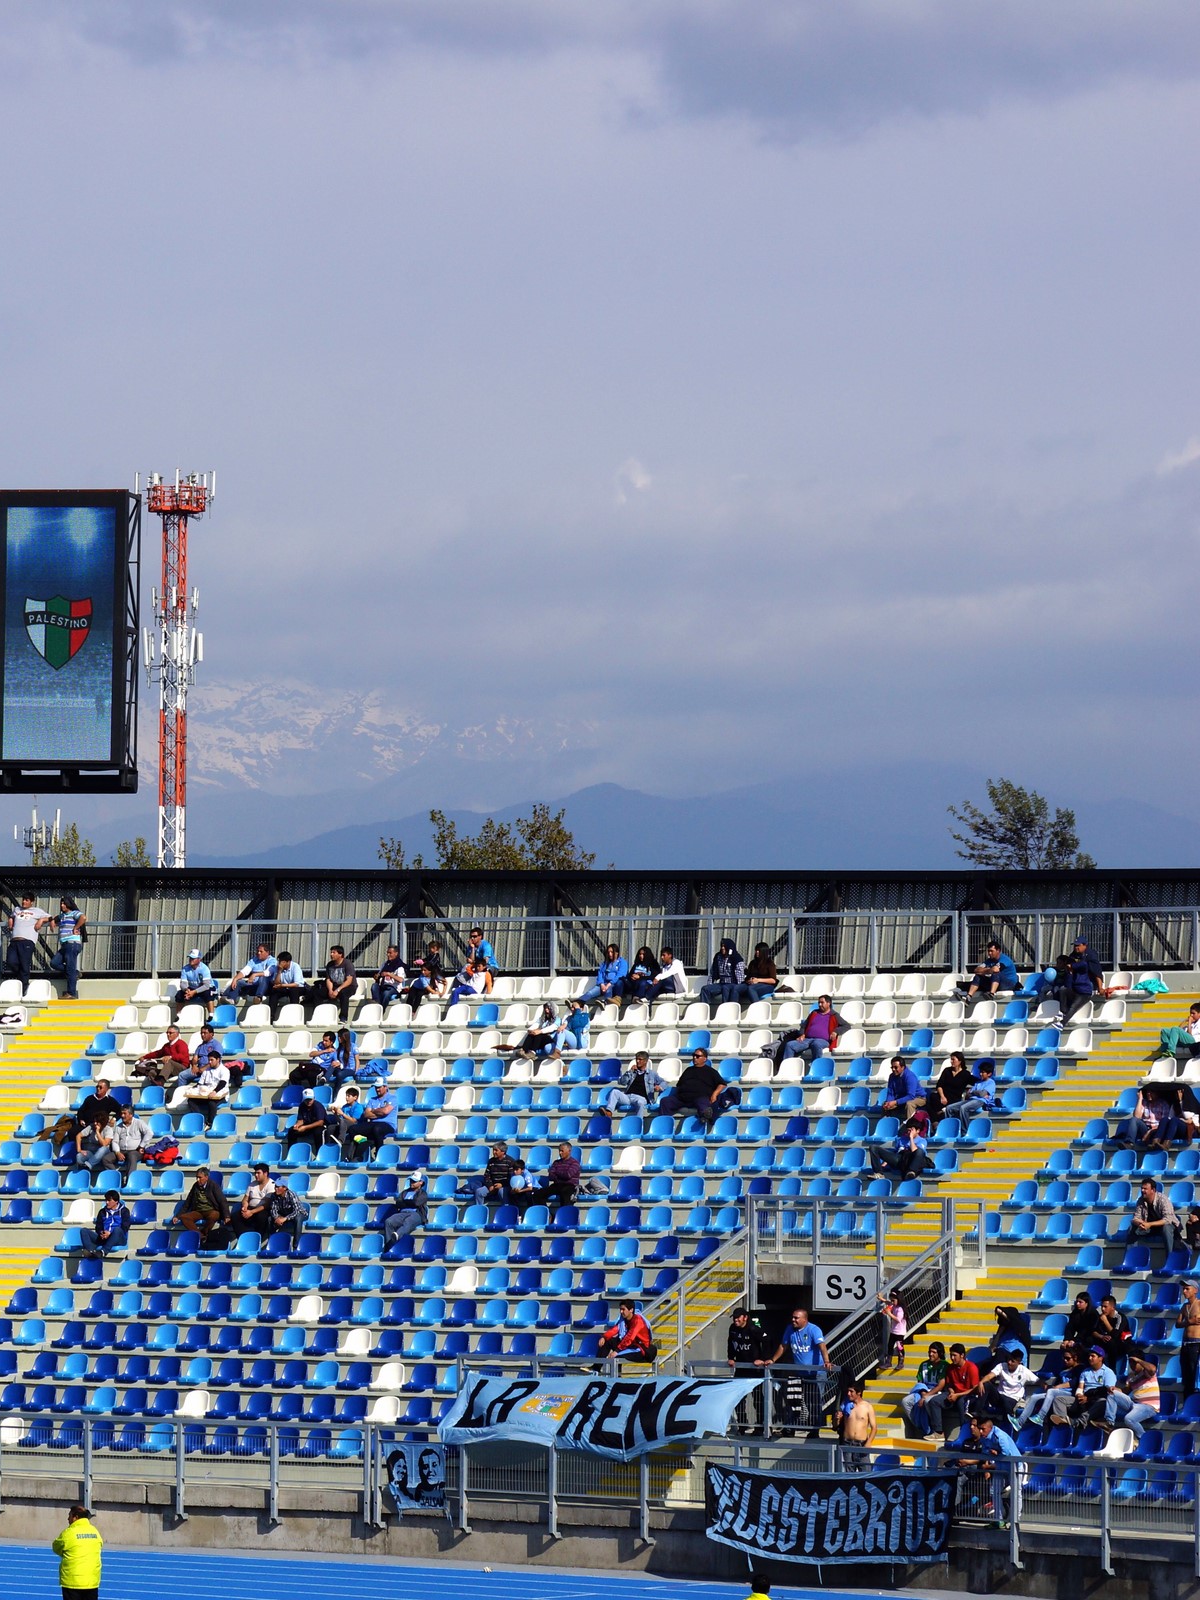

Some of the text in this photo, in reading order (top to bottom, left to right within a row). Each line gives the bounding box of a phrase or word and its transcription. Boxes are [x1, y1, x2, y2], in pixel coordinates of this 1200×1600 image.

[28, 614, 88, 628] PALESTINO
[826, 1274, 867, 1301] S-3
[739, 1343, 752, 1351] vtr
[556, 1379, 734, 1450] RENE
